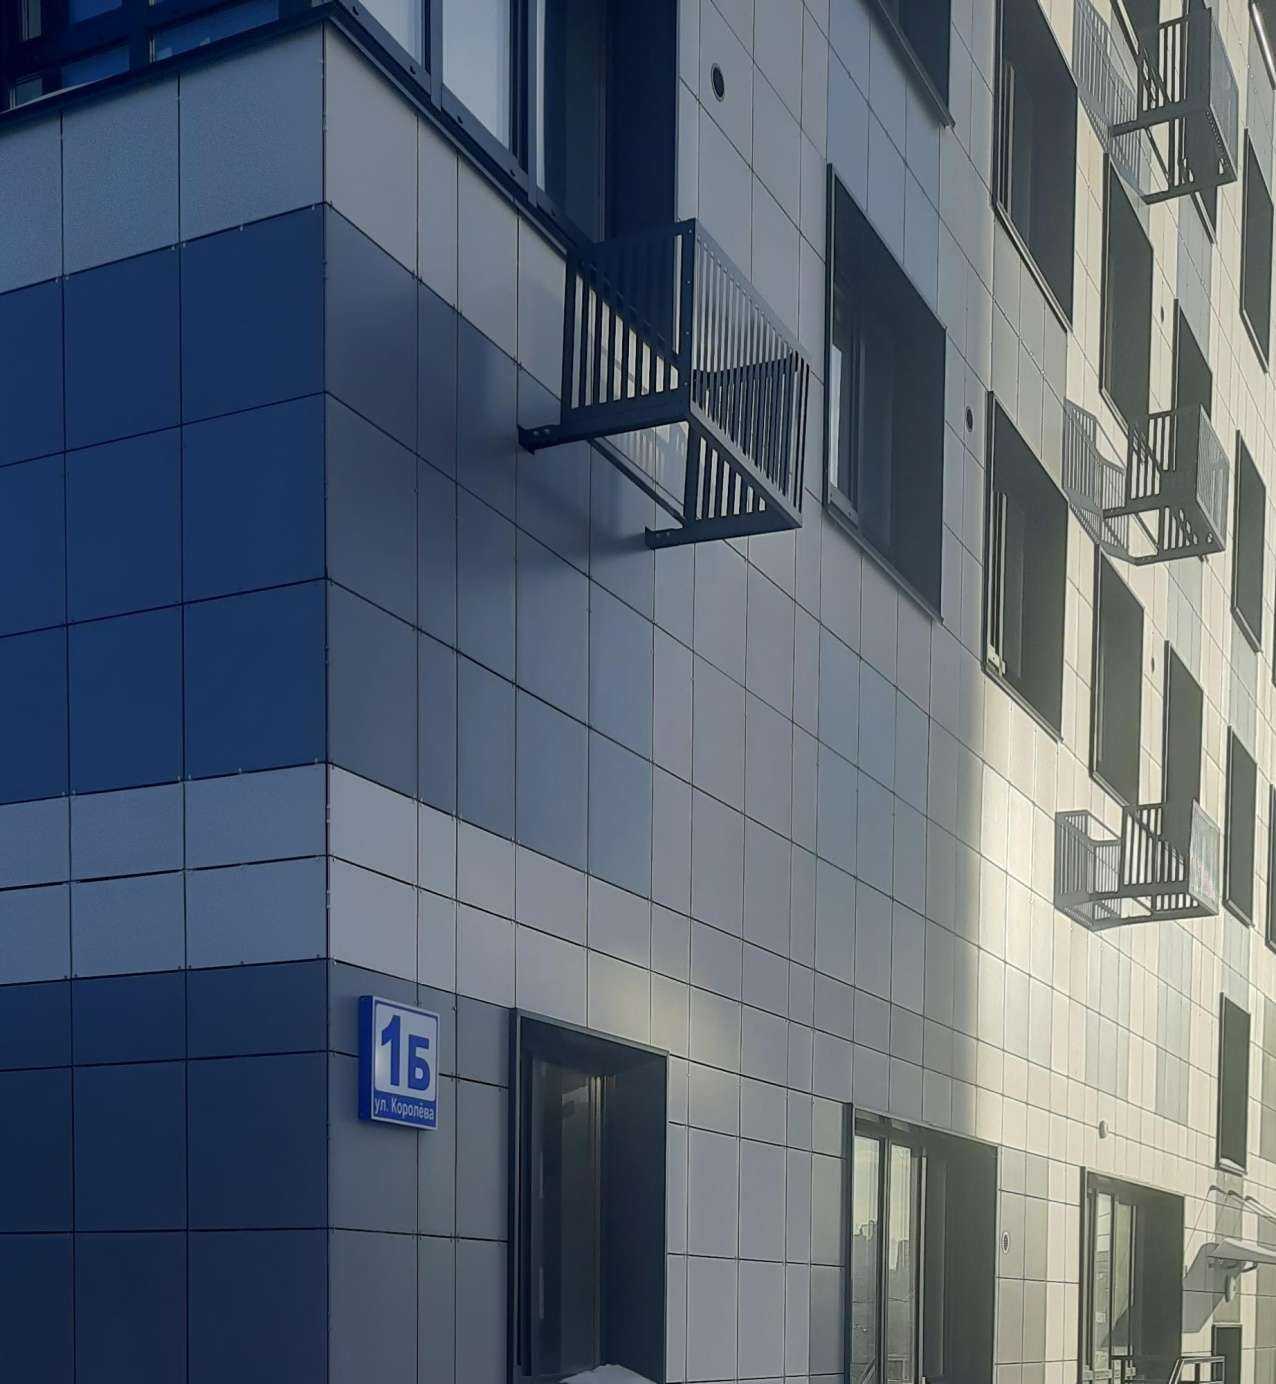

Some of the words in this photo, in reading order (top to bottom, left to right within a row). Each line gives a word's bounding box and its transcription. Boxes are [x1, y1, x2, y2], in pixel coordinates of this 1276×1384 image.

[381, 1014, 430, 1091] 1Б
[374, 1096, 389, 1114] ул.
[391, 1095, 435, 1121] Королёва
